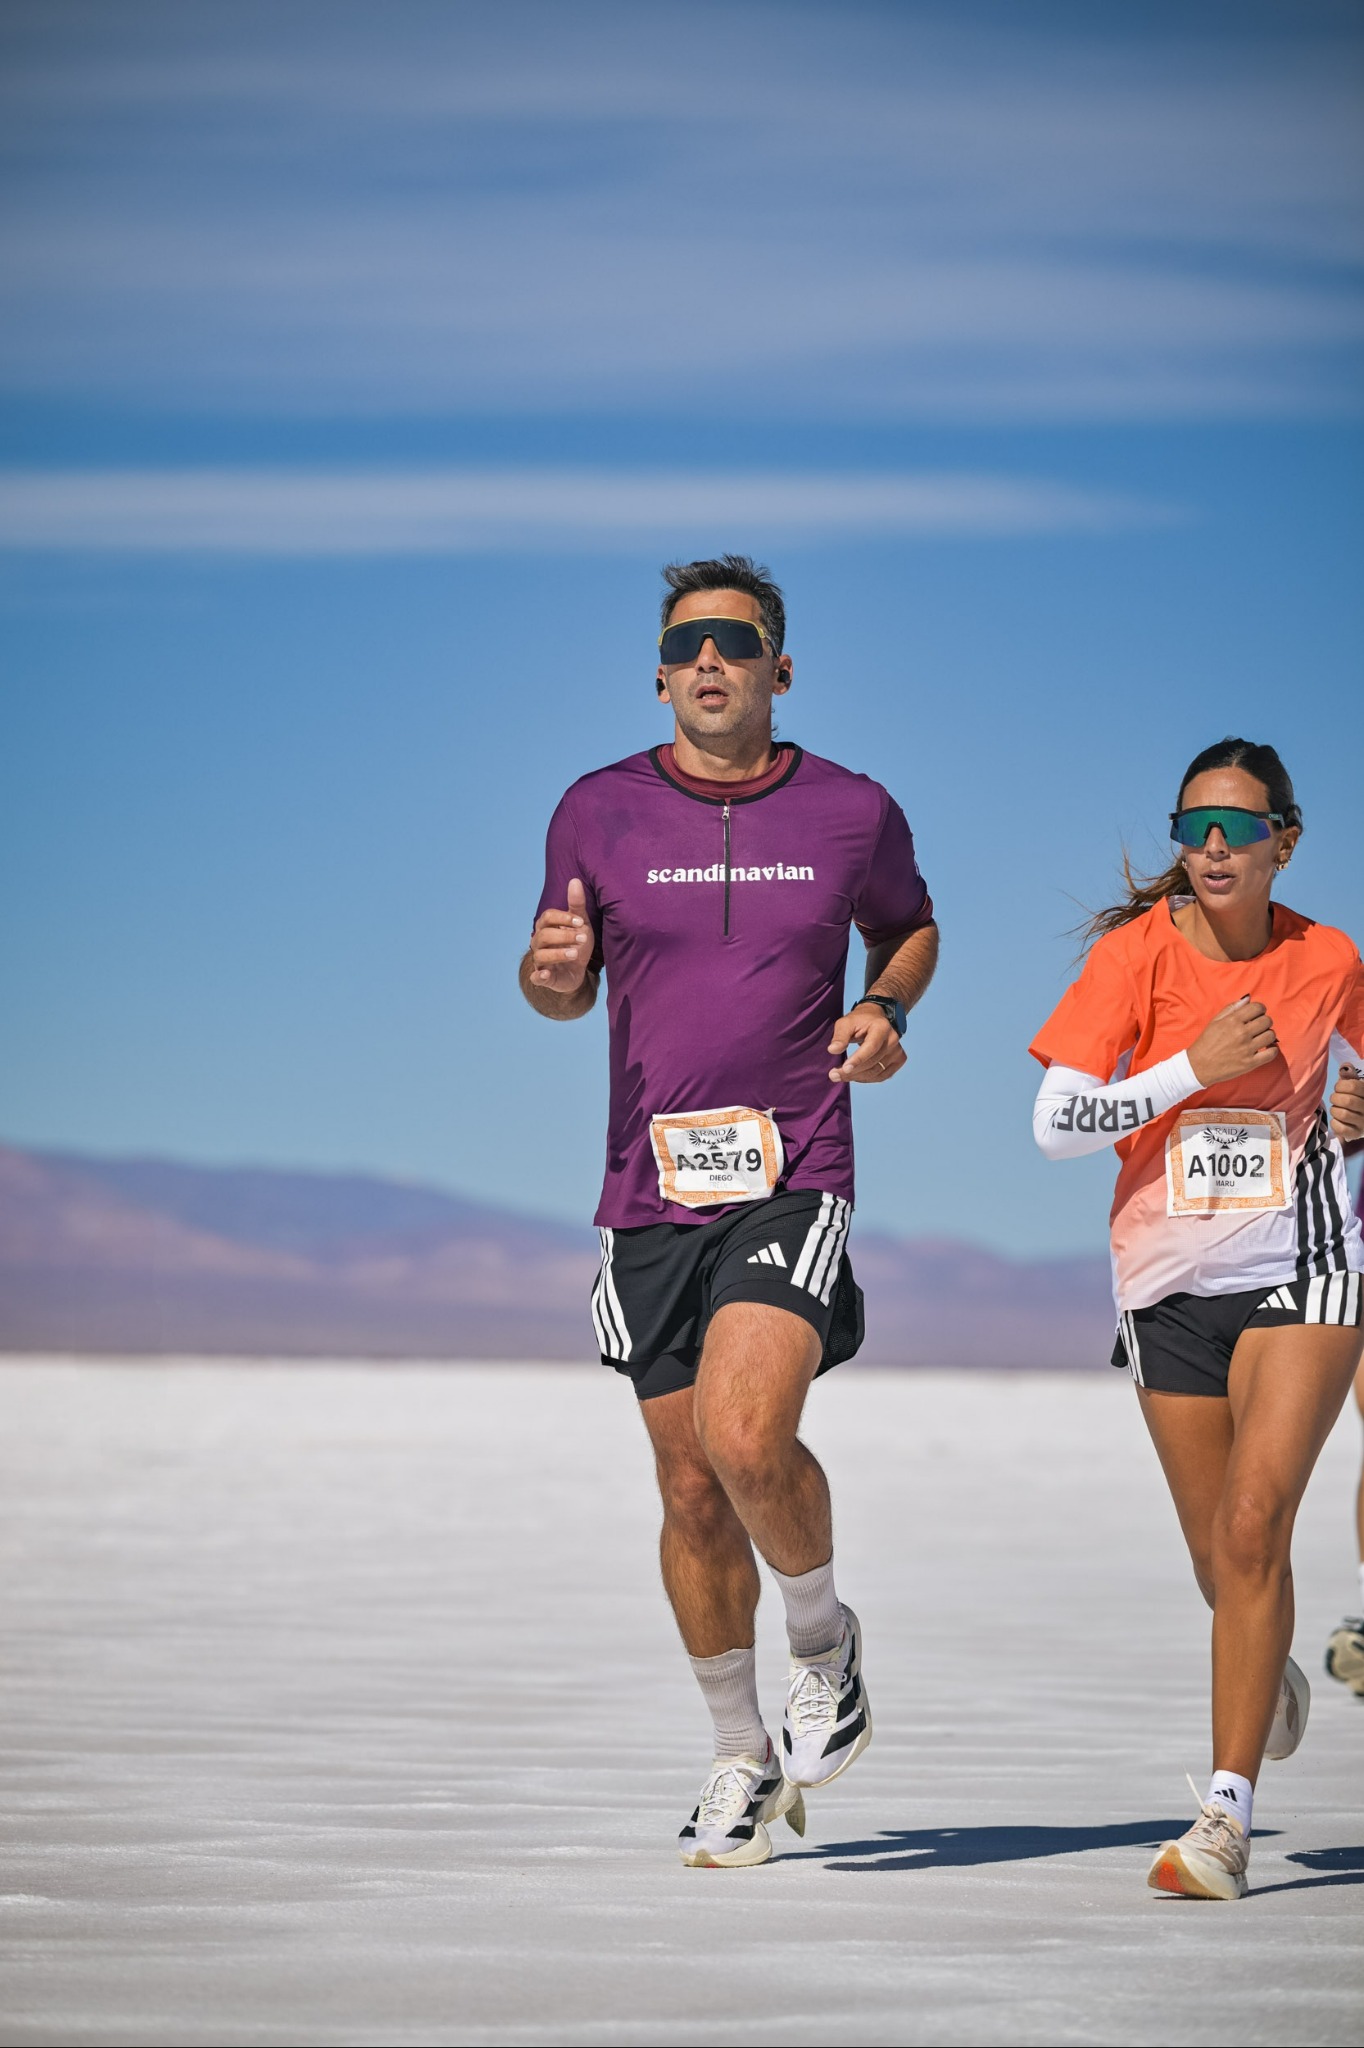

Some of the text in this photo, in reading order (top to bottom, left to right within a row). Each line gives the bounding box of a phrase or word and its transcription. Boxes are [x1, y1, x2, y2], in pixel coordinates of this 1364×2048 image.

[646, 862, 815, 884] scandinavian
[1052, 1095, 1162, 1133] TERRE
[699, 1128, 727, 1136] RAID
[1214, 1127, 1238, 1136] RAID
[677, 1148, 762, 1172] A2579
[1187, 1153, 1265, 1179] A1002
[1215, 1179, 1236, 1187] MARU
